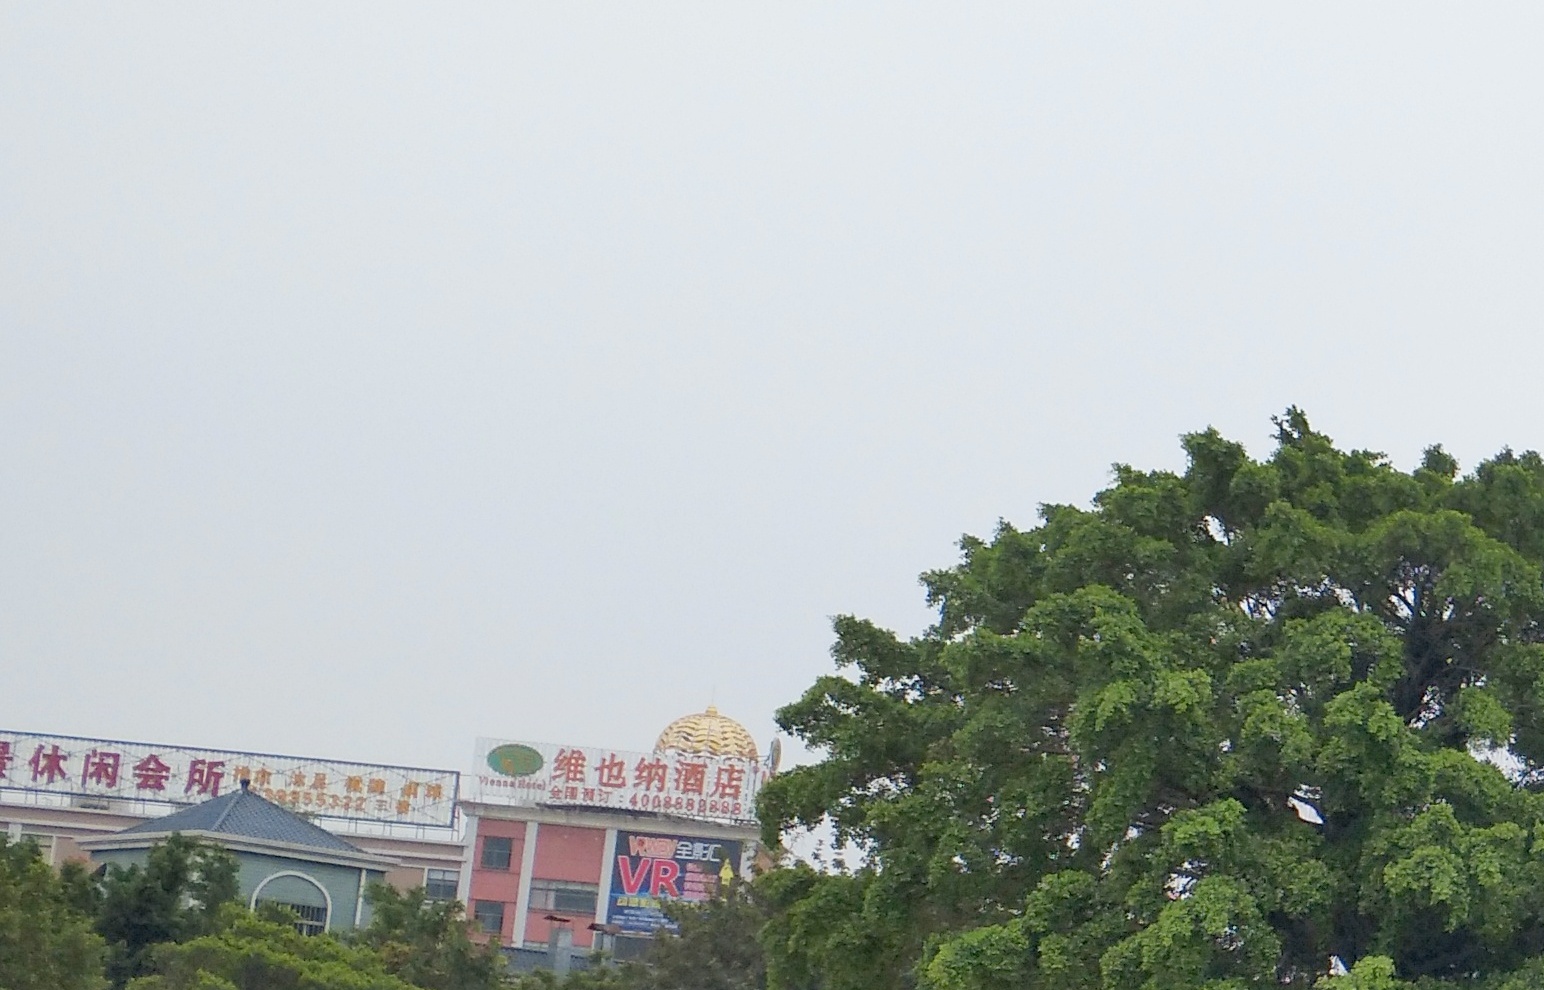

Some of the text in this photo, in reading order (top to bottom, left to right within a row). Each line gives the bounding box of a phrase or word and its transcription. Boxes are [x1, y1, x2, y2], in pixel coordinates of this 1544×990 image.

[479, 776, 546, 791] Vienna Hotel
[552, 748, 746, 801] 维也纳酒店
[617, 855, 681, 899] VR
